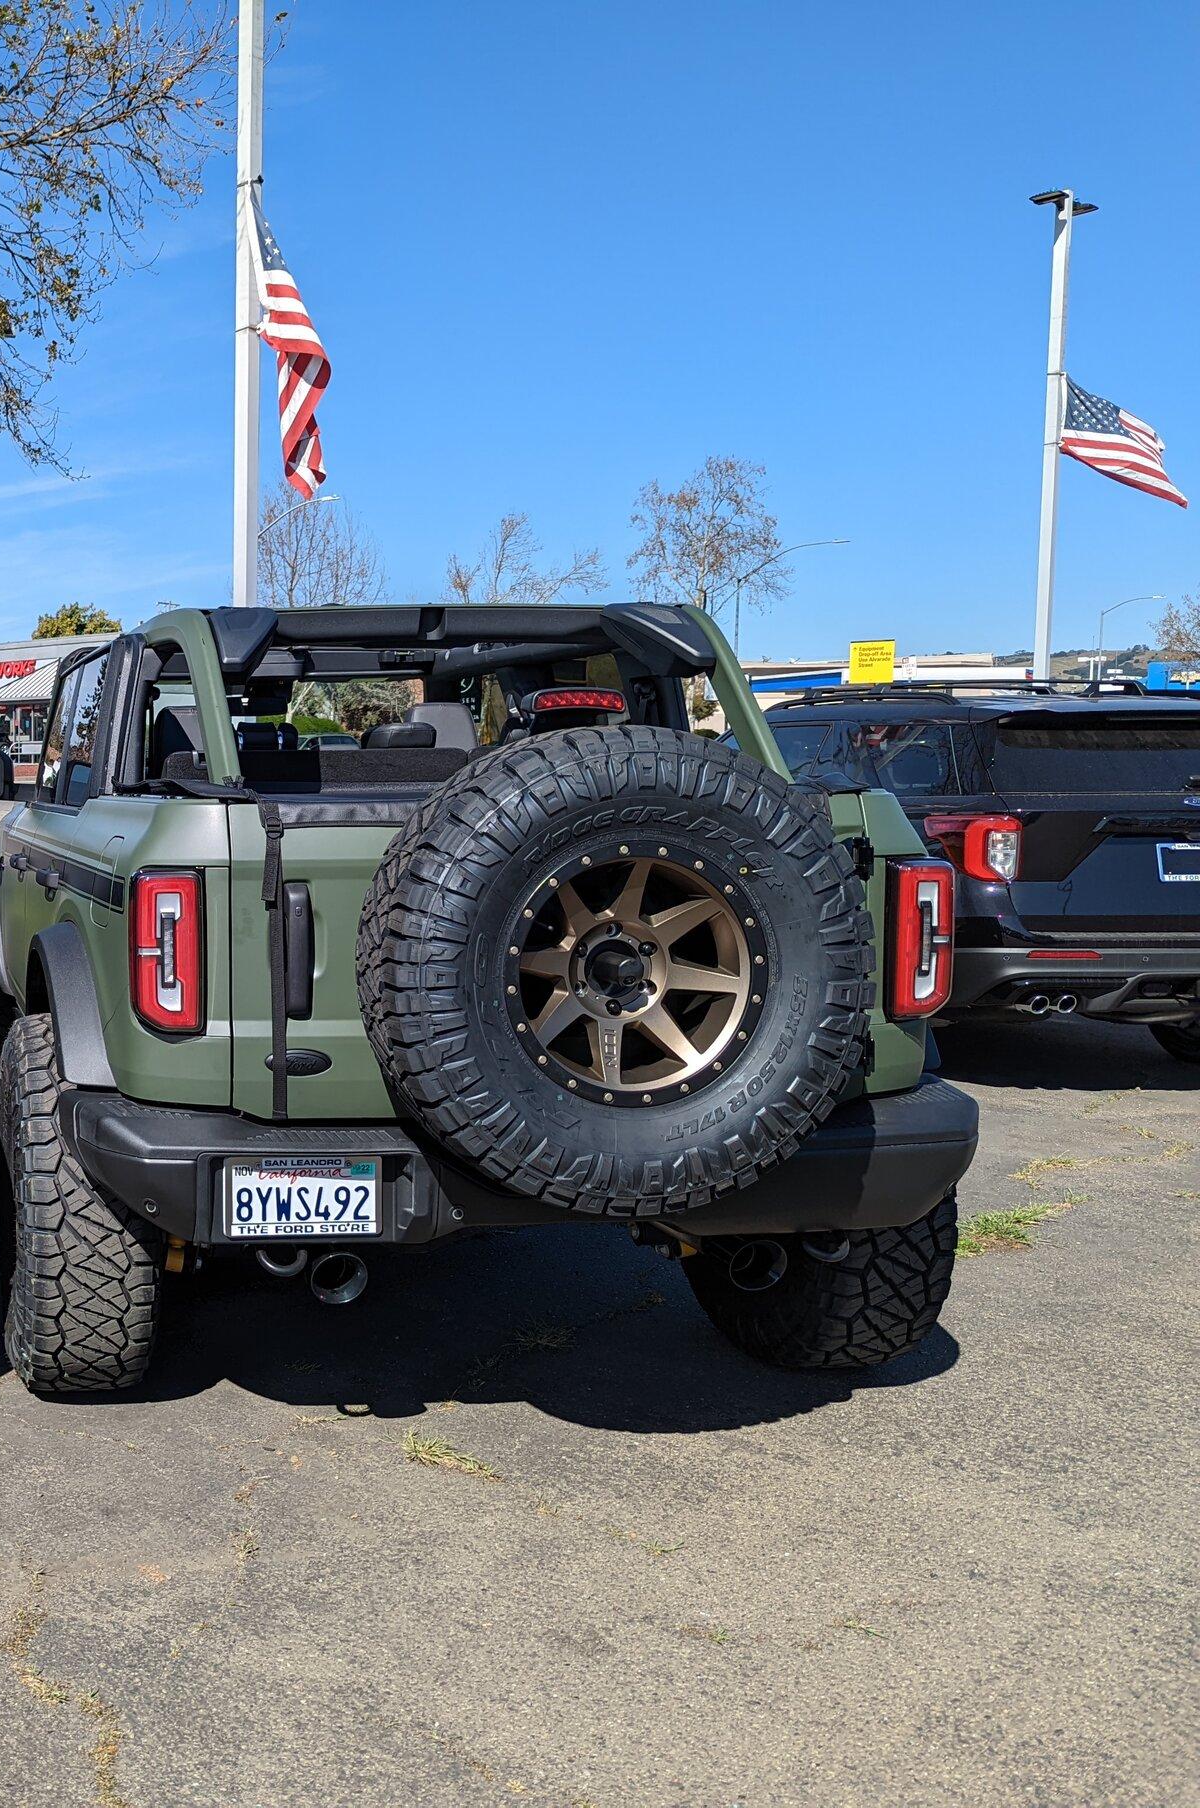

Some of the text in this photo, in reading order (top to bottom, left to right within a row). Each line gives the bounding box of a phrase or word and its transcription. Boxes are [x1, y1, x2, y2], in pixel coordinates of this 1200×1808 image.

[264, 1158, 342, 1167] SAN LEANDRO
[234, 1166, 254, 1177] NOV
[236, 1185, 371, 1222] 8YWS492
[237, 1223, 371, 1235] THE FORD STORE
